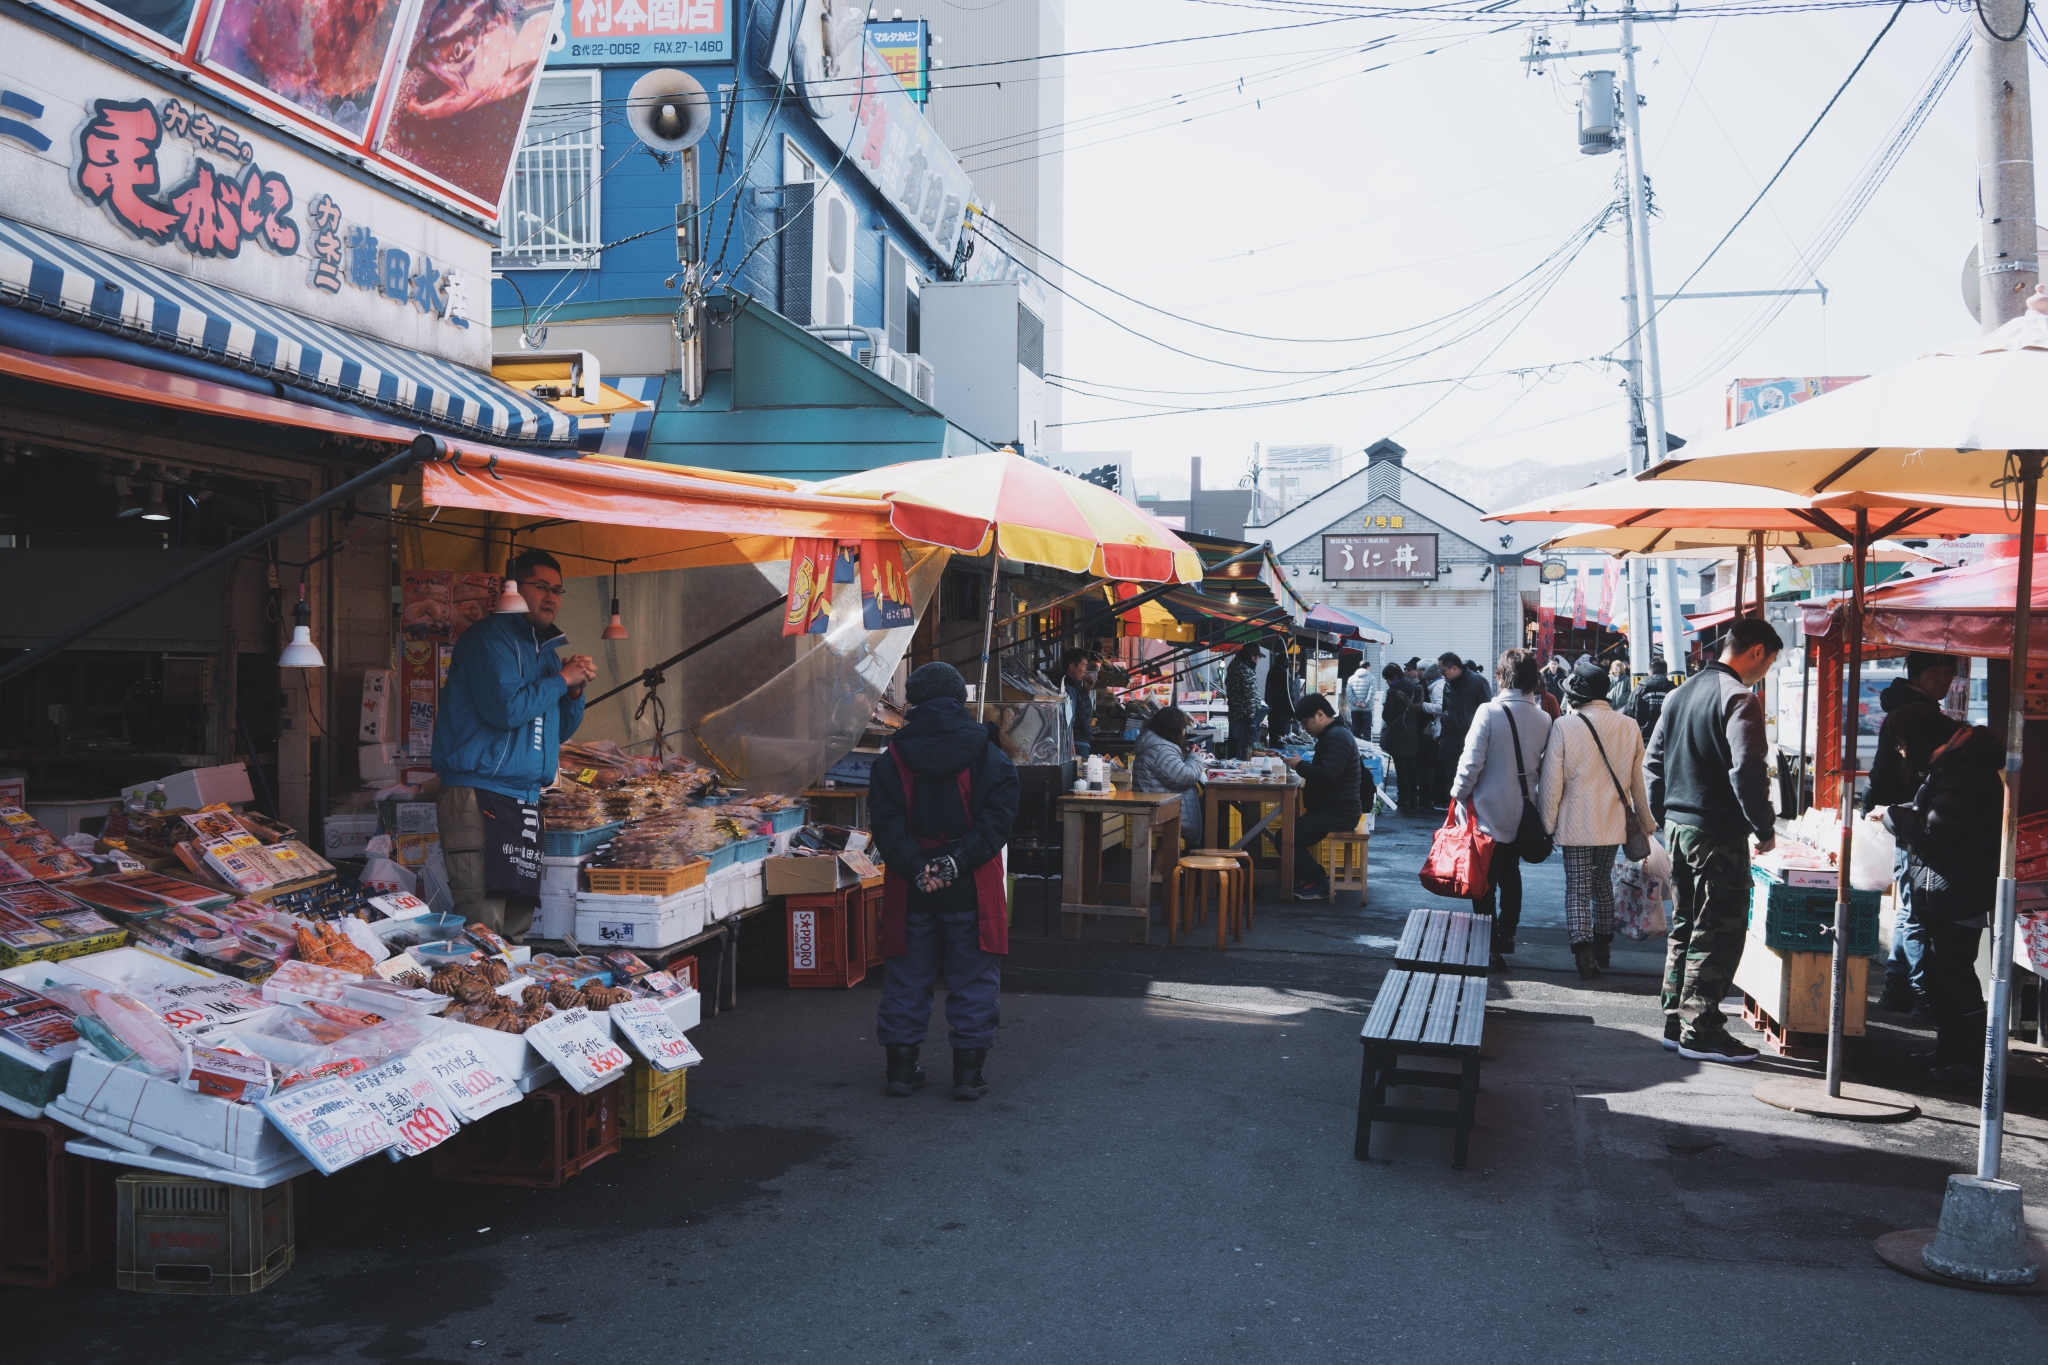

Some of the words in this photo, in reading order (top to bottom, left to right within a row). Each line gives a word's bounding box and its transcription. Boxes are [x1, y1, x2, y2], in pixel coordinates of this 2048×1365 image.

[577, 0, 715, 33] 村本商店
[653, 41, 723, 54] FAX.27-1460
[164, 99, 253, 162] カネニの
[313, 194, 342, 294] カネニ
[351, 227, 469, 329] 藤田水産
[1340, 543, 1419, 575] うに丼
[1943, 541, 1985, 549] Hakodate
[411, 700, 433, 718] EMS
[397, 895, 421, 909] 500
[600, 926, 624, 940] 毛がに
[800, 913, 813, 967] SPPORO
[661, 1039, 689, 1058] 5000
[462, 1069, 497, 1096] 6000
[343, 1121, 391, 1155] 6000
[399, 1106, 450, 1152] 1080
